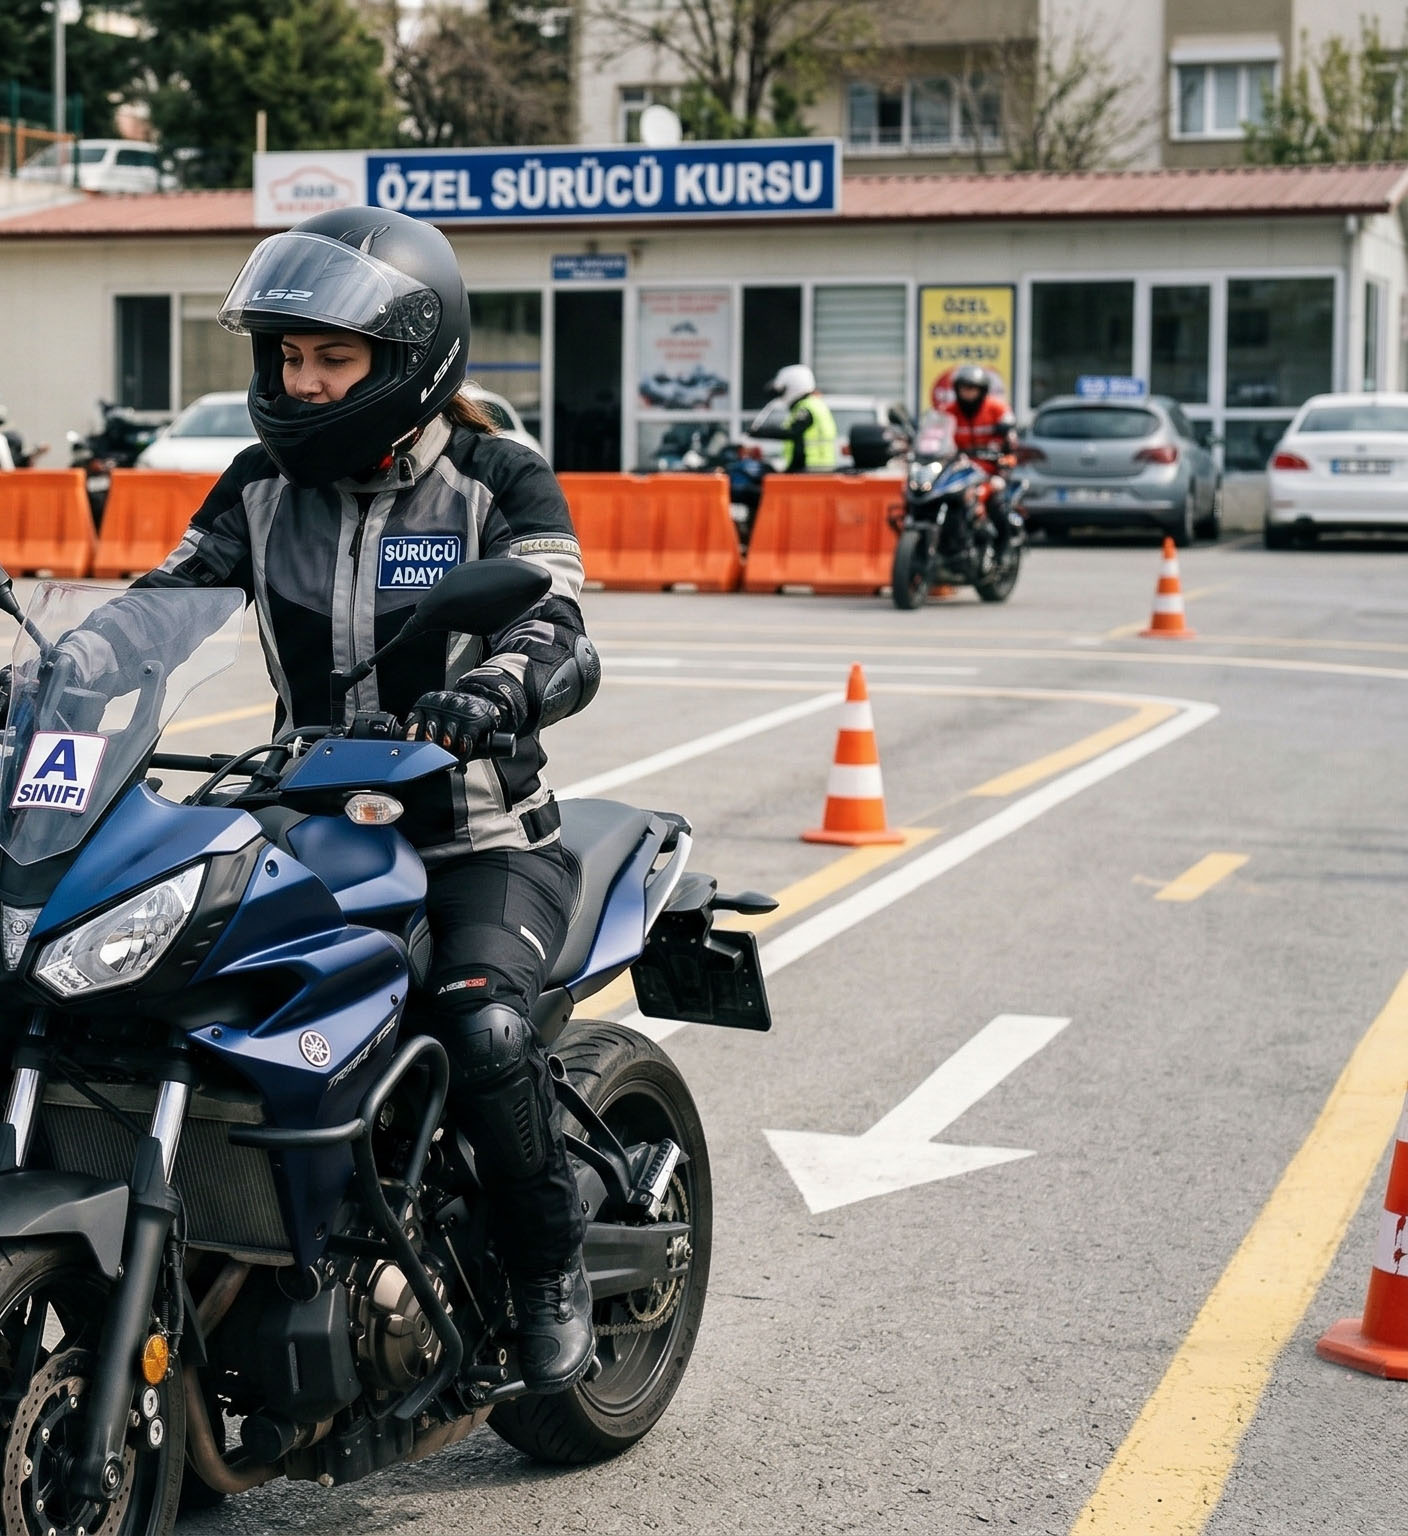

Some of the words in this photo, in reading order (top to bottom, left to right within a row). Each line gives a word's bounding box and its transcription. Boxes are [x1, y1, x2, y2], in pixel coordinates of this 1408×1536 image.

[376, 163, 482, 211] ÖZEL
[491, 157, 664, 210] SÜRÜCÜ
[674, 160, 824, 206] KURSU
[252, 289, 314, 302] LS2
[943, 295, 990, 314] ÖZEL
[933, 346, 1000, 360] KURSU
[420, 336, 461, 404] LS2
[384, 540, 456, 562] SÜRÜCÜ
[391, 566, 443, 585] ADAYI
[33, 738, 78, 781] A
[17, 783, 85, 806] SINIFI
